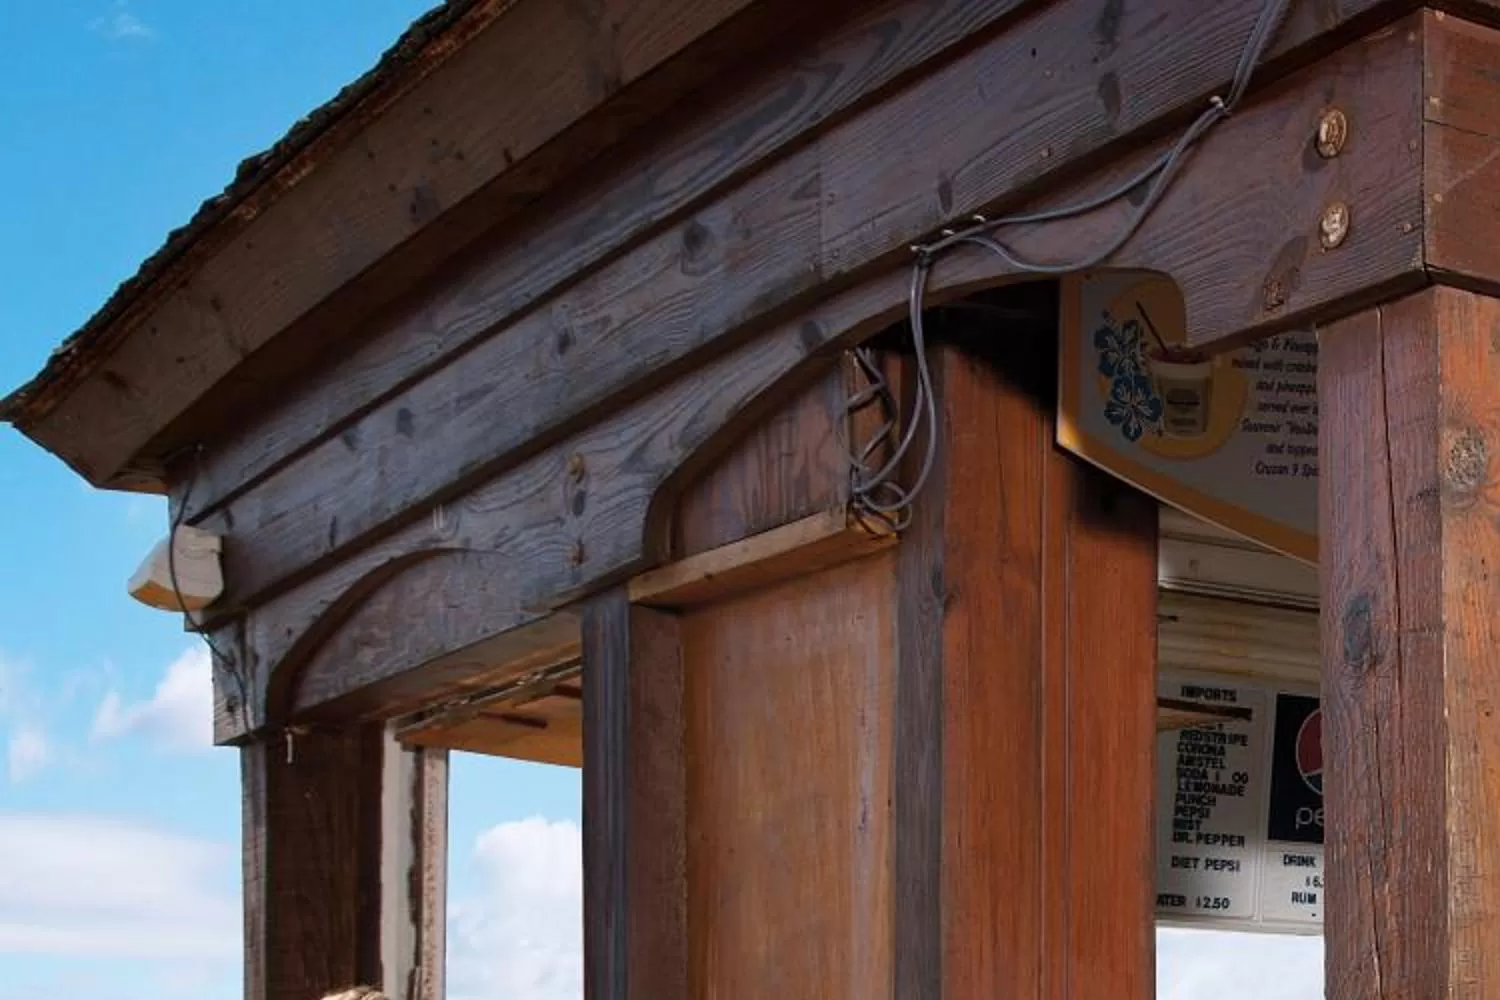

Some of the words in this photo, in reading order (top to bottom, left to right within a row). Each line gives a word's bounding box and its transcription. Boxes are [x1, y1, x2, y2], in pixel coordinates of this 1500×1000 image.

[1256, 379, 1274, 392] and
[1266, 443, 1285, 454] and
[1181, 686, 1237, 702] IMPORTS
[1177, 741, 1226, 756] CORONA
[1177, 754, 1226, 769] AMSTEL
[1177, 779, 1245, 797] LEMONADE
[1175, 792, 1217, 807] PUNCH
[1174, 806, 1211, 819] PEPSI
[1196, 833, 1245, 848] PEPPER
[1171, 855, 1201, 869] DIET
[1204, 857, 1241, 872] PEPSI
[1283, 853, 1317, 867] DRINK
[1157, 894, 1186, 907] ATER
[1291, 891, 1317, 905] RUM
